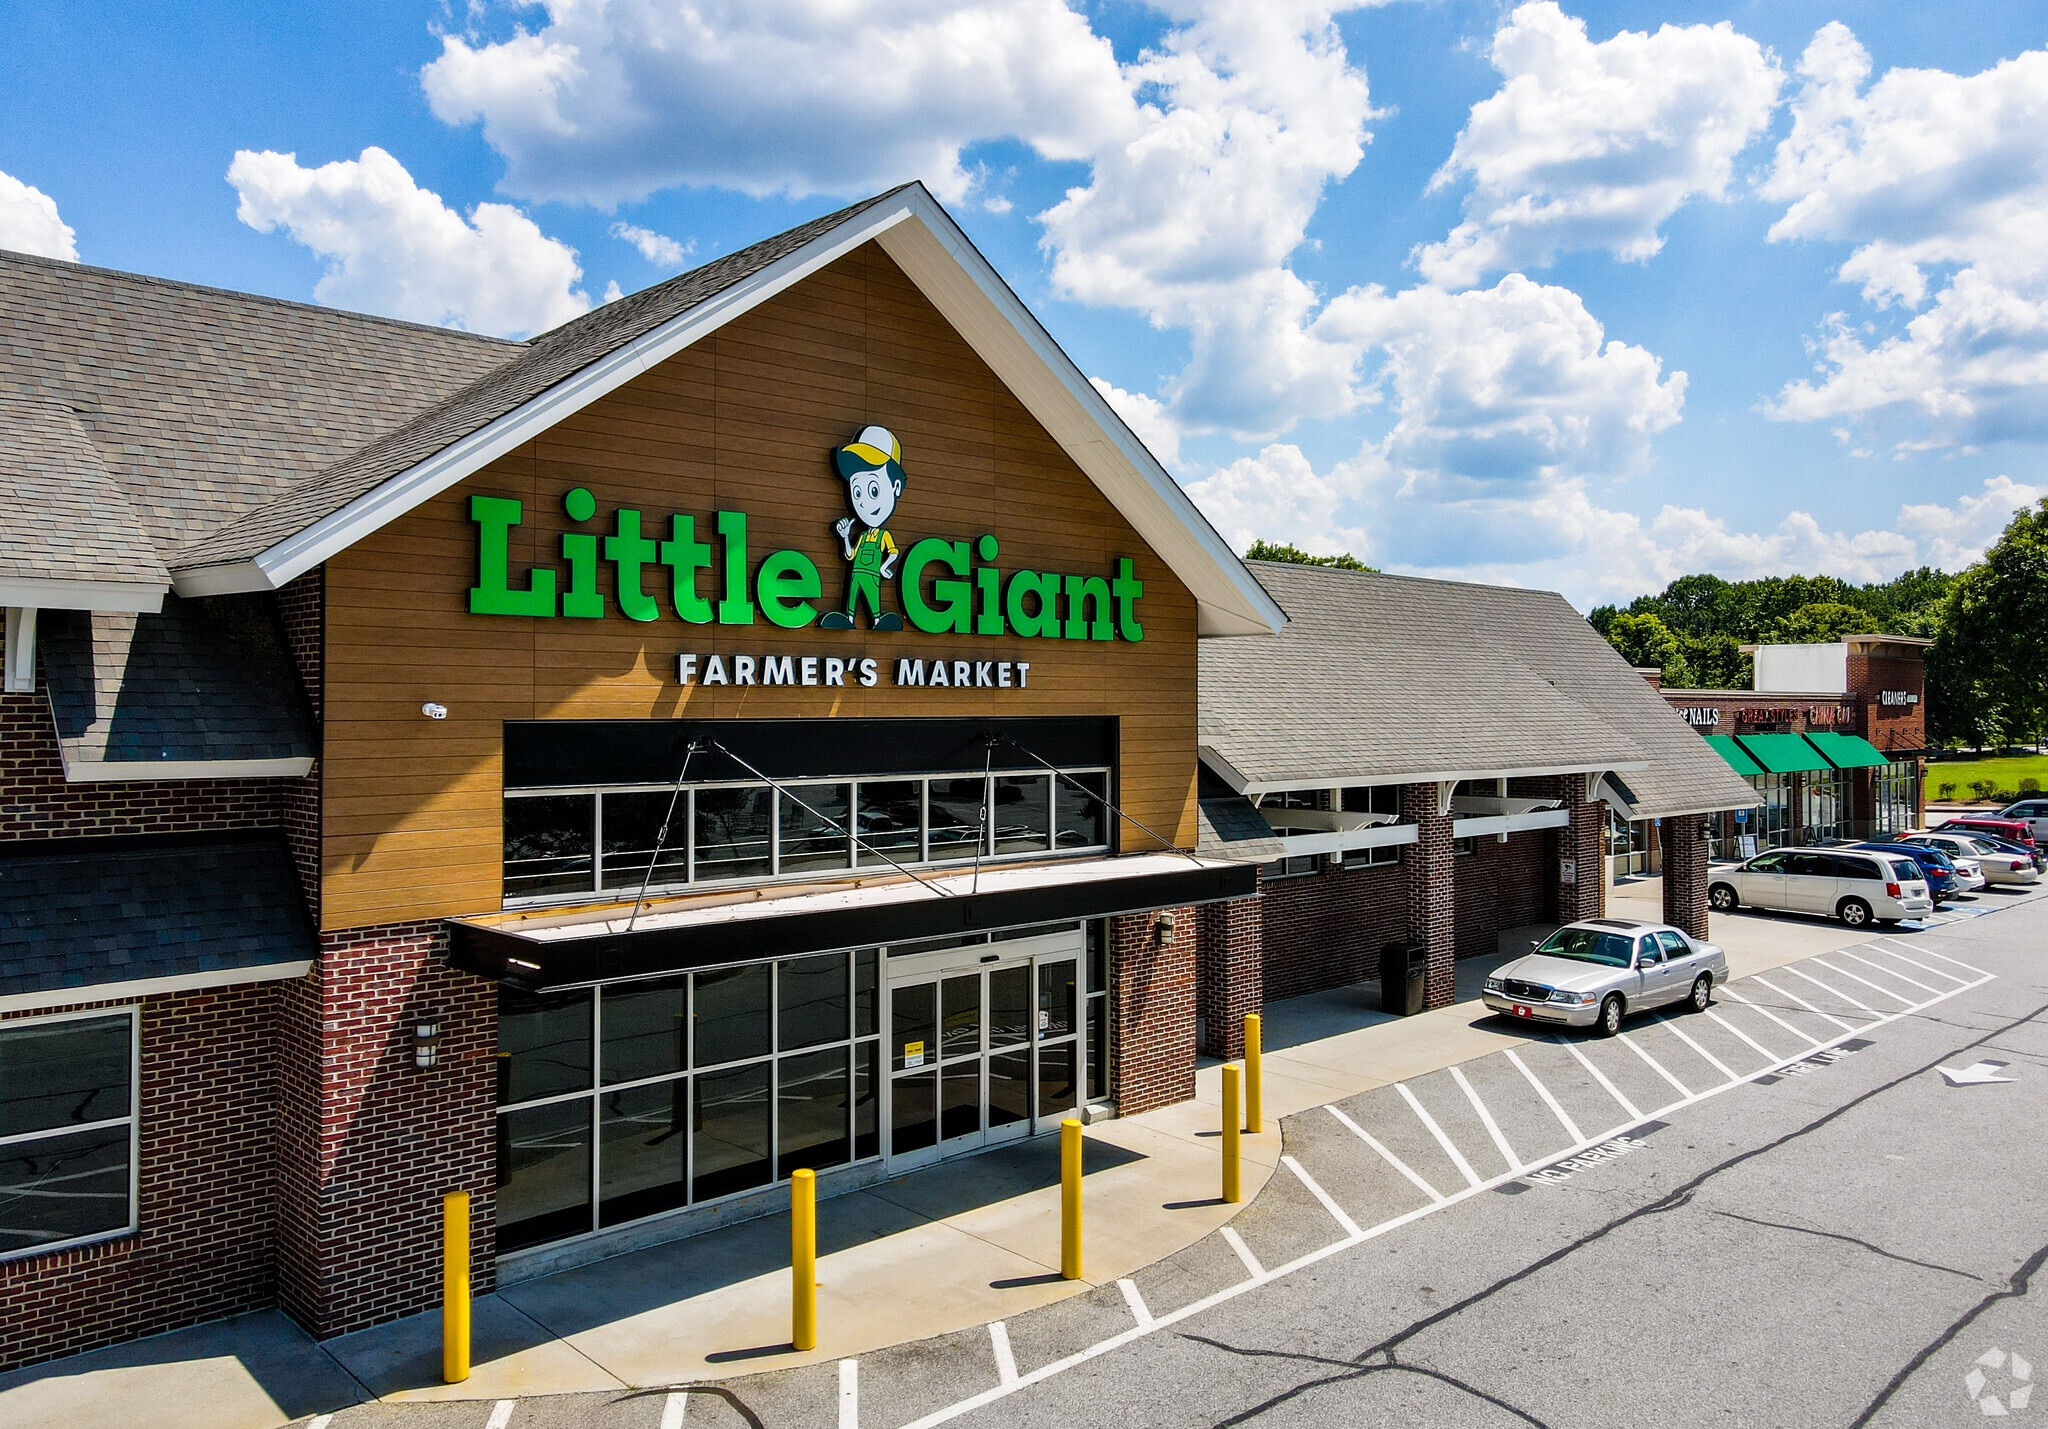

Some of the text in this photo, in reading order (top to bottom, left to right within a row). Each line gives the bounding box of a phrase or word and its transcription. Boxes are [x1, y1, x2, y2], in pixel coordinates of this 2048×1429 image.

[467, 487, 1145, 642] Little Giant
[676, 653, 1031, 688] FARMER'S MARKET
[1881, 690, 1907, 706] CLEANERS
[1689, 707, 1719, 725] NAILS
[1741, 708, 1799, 723] GREAT STYLES
[1525, 1136, 1649, 1186] NO PARKING
